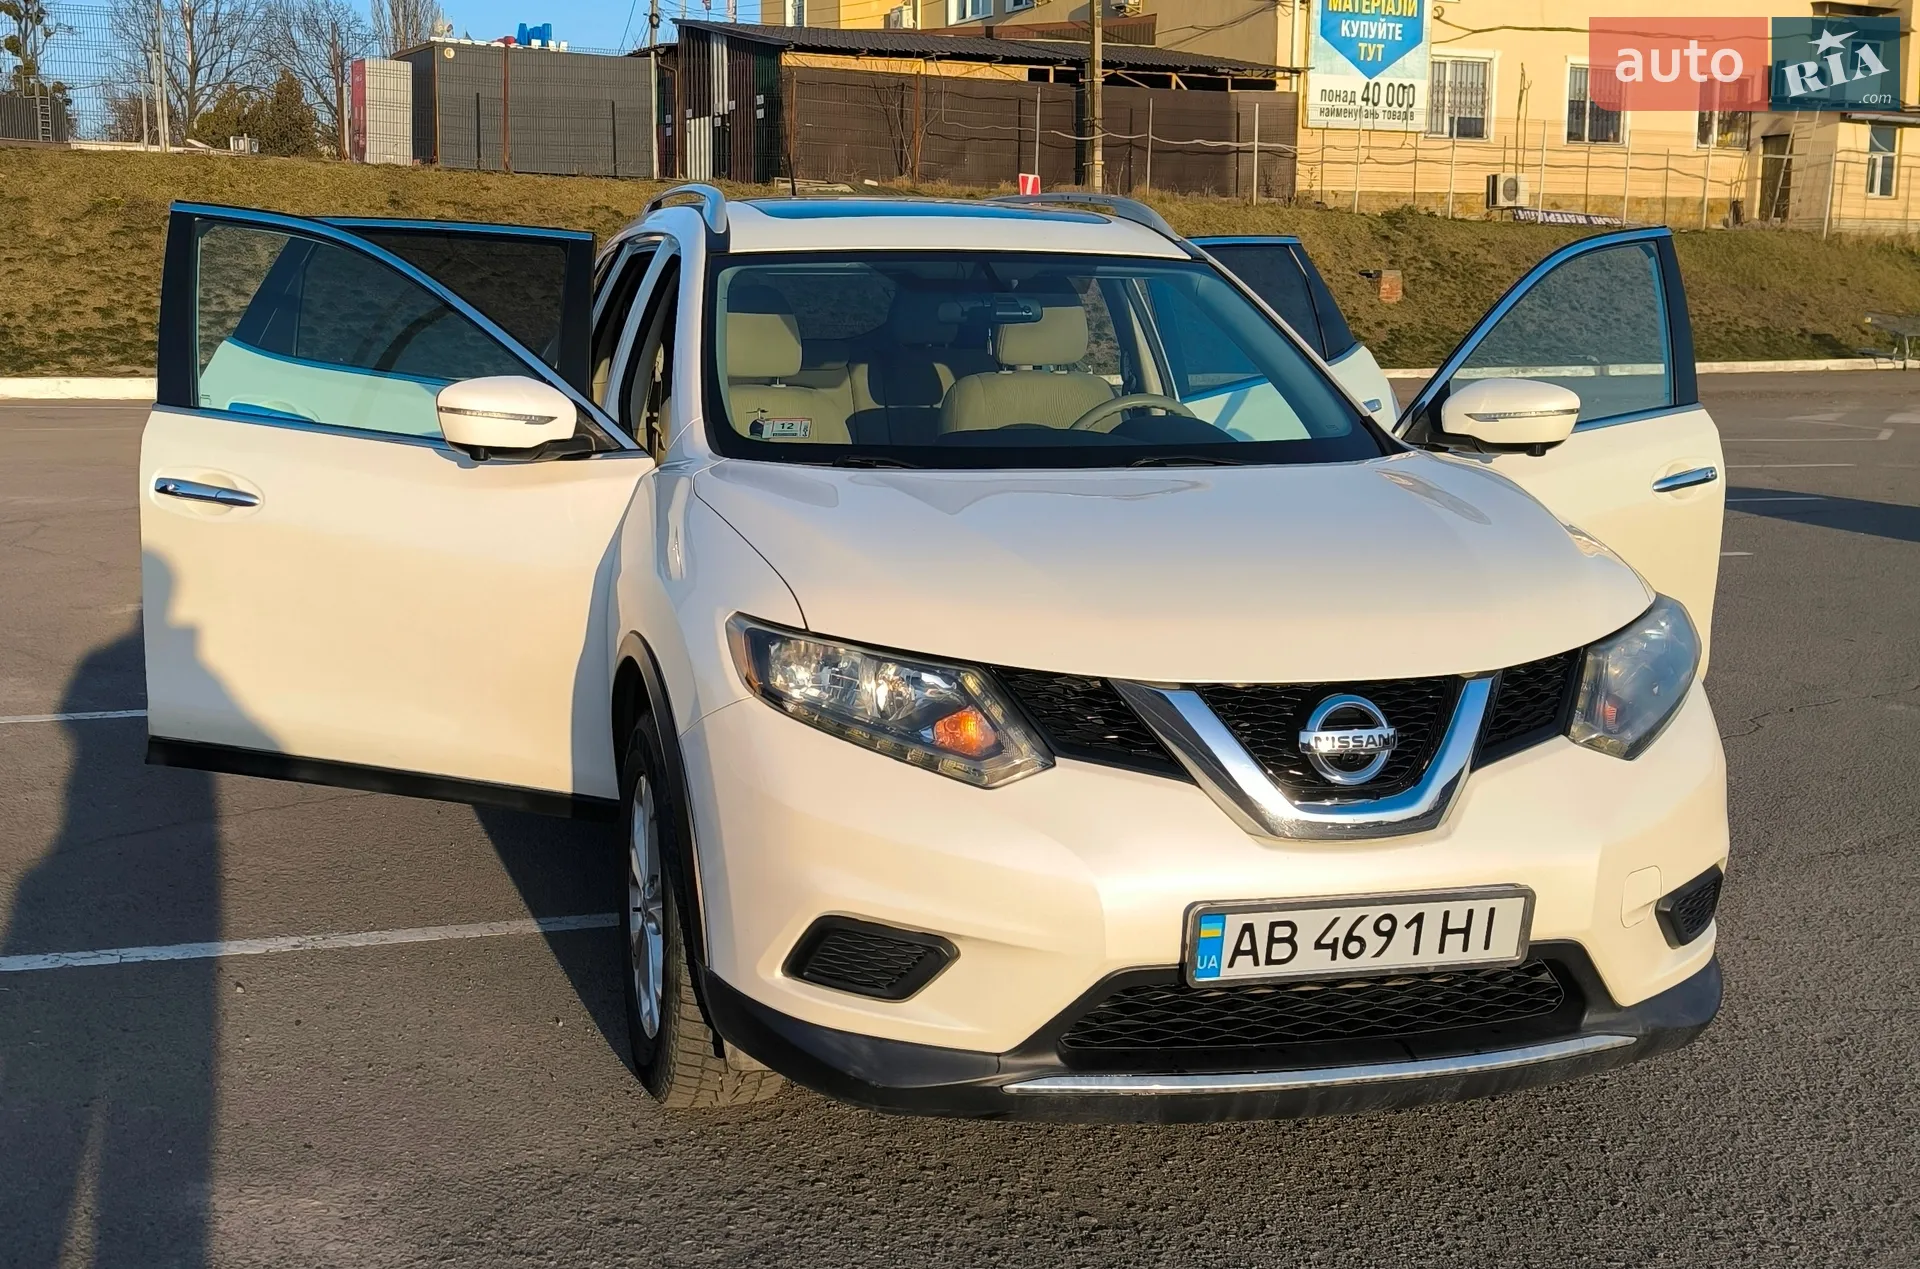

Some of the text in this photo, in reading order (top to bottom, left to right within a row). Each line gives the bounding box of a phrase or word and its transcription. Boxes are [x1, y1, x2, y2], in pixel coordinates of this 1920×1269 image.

[1328, 0, 1418, 17] МАТЕРІАЛИ
[1341, 18, 1404, 41] КУПУЙТЕ
[1358, 42, 1386, 62] ТУТ
[1320, 88, 1357, 106] понад
[1361, 81, 1381, 107] 40
[1382, 109, 1415, 123] товарв
[780, 422, 795, 430] 12
[1314, 733, 1393, 749] NISSAN
[1227, 906, 1496, 969] AB 4691 HI
[1197, 954, 1219, 970] UA
